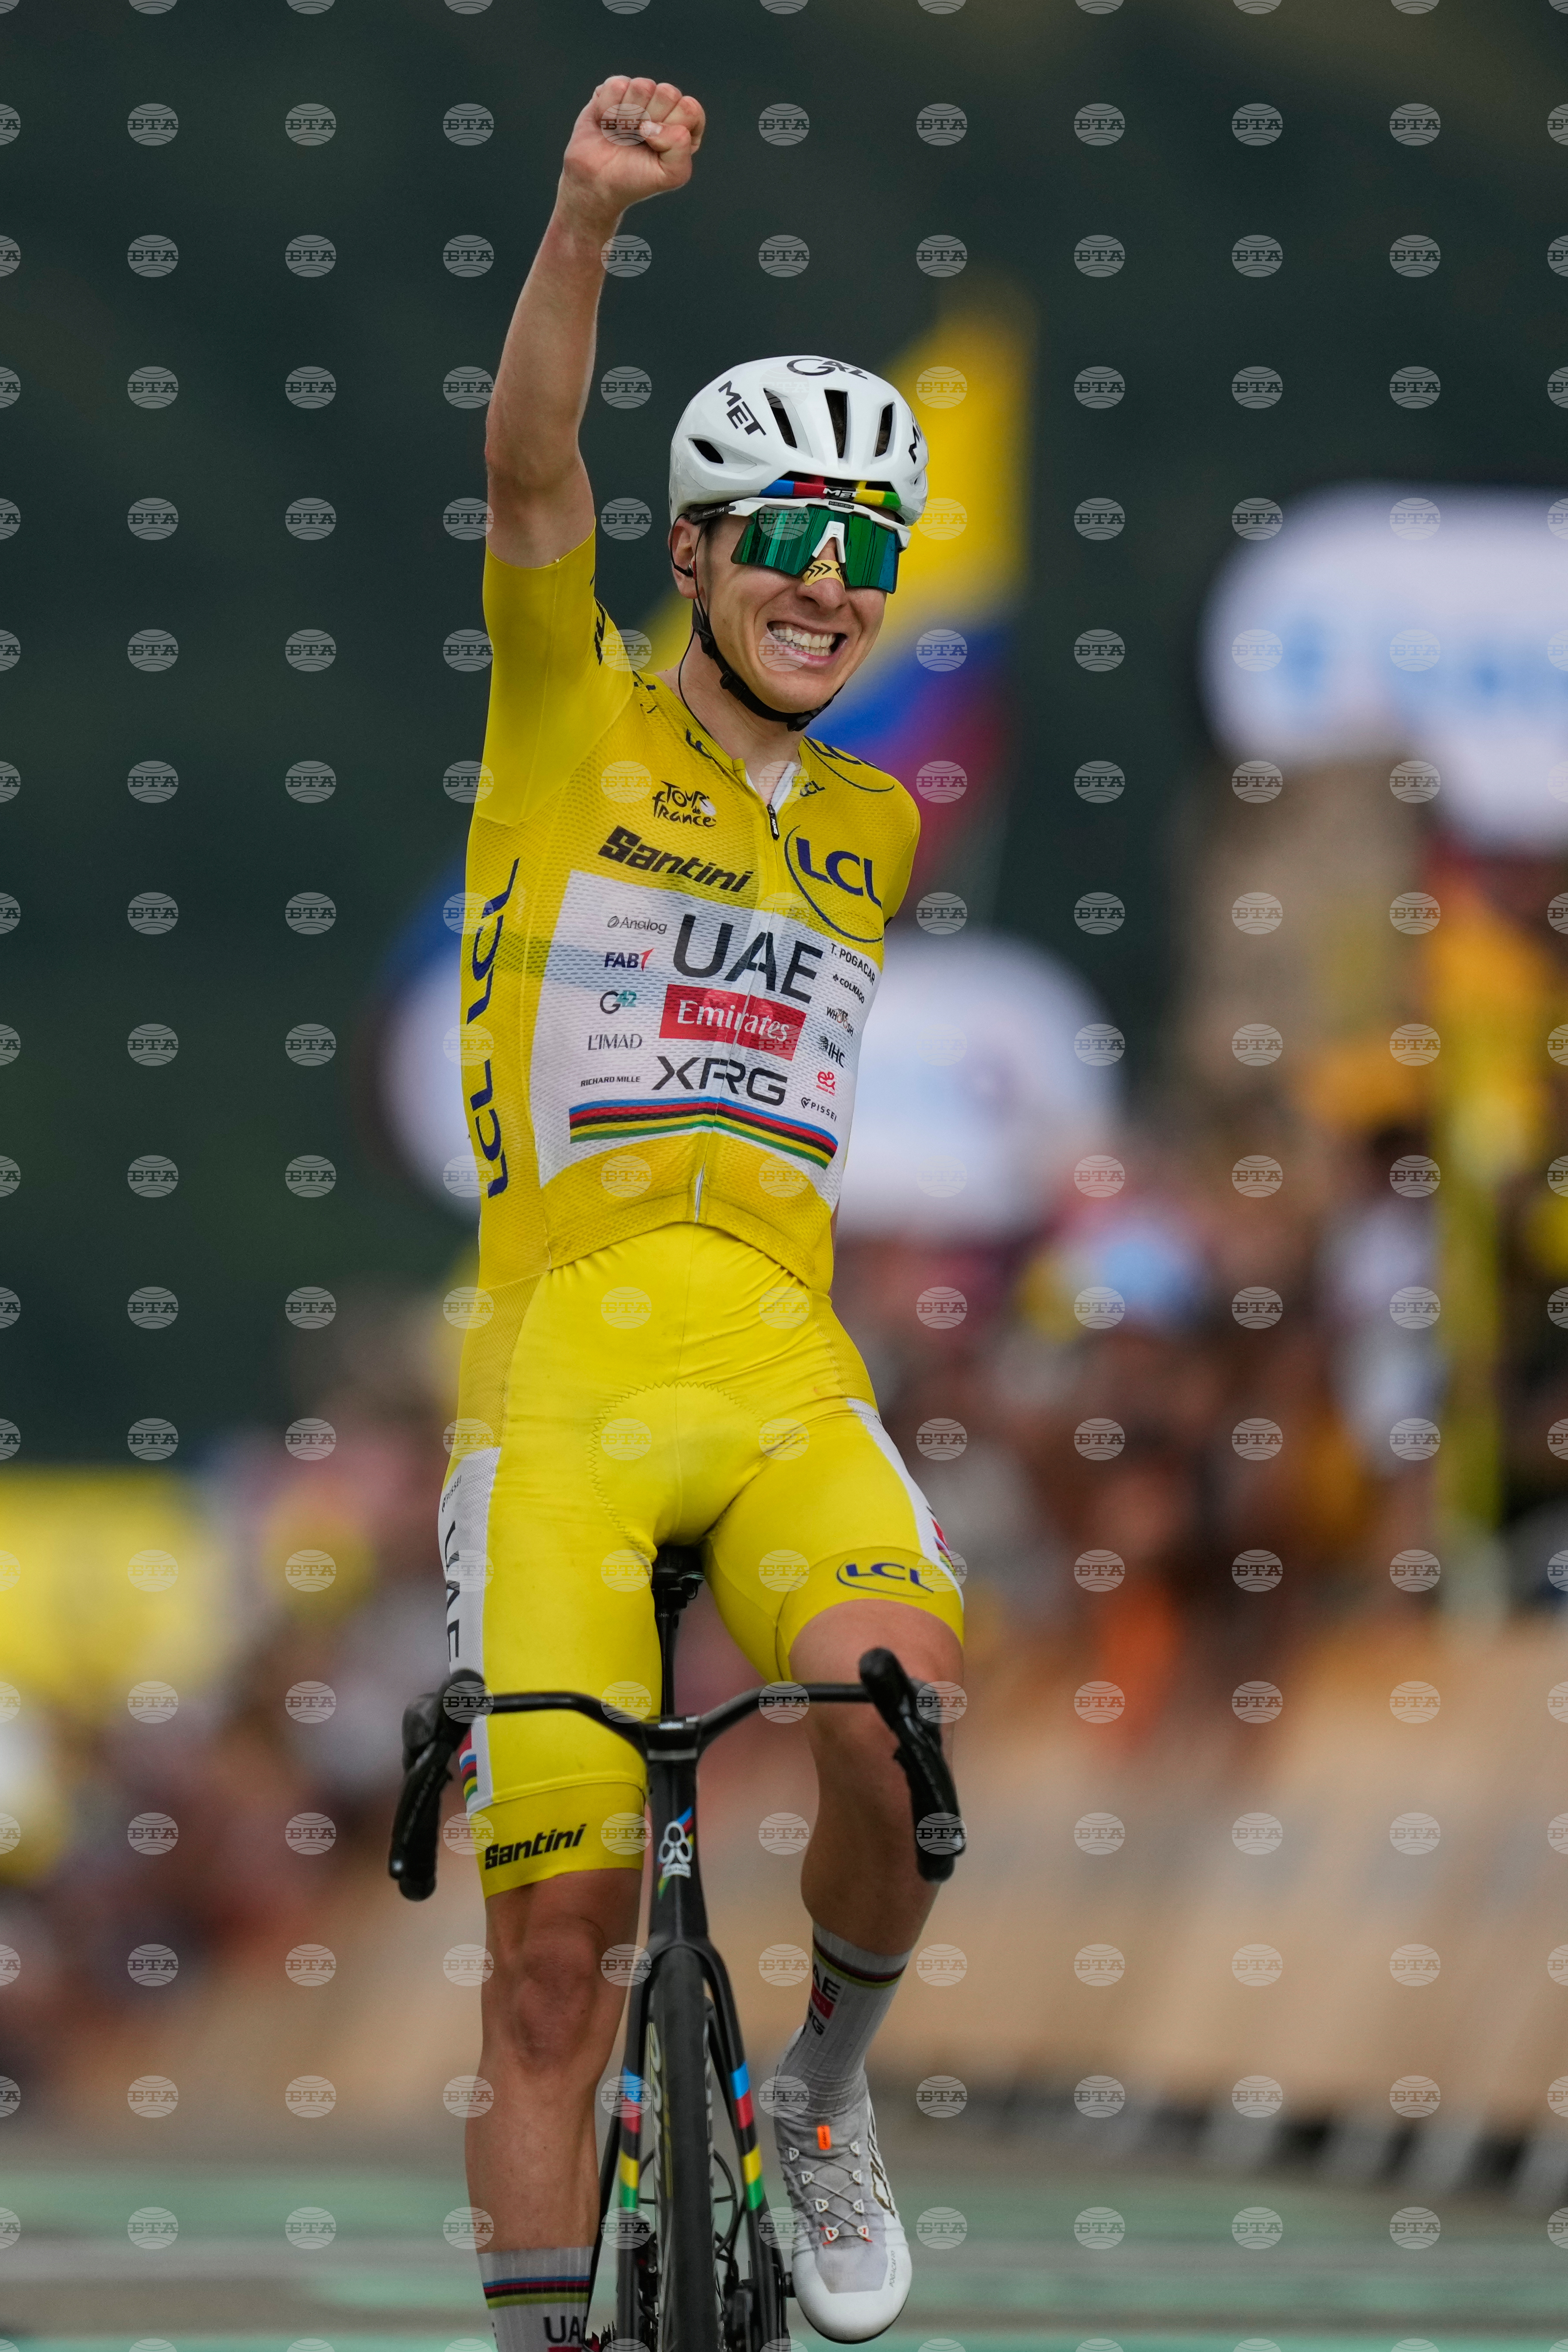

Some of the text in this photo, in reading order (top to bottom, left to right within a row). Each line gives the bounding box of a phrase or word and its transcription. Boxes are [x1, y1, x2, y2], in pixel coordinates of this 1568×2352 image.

[718, 380, 766, 436] MET
[823, 487, 861, 498] MET
[686, 728, 712, 759] LC
[799, 780, 825, 797] LCL
[598, 825, 754, 893] Santini
[795, 837, 882, 911] LCL
[467, 858, 520, 1025] LCL
[619, 917, 667, 934] Analog
[673, 914, 823, 1004] UAE
[831, 943, 875, 986] T. POGACAR
[600, 990, 637, 1014] G42
[840, 978, 865, 1004] COLNAGO
[677, 999, 789, 1042] Emirates
[828, 1042, 845, 1068] IHC
[580, 1076, 615, 1087] RICHARD
[651, 1056, 788, 1106] XRG
[470, 1059, 508, 1199] LCL
[811, 1101, 837, 1122] PISSEI
[845, 1562, 934, 1593] LCL
[485, 1823, 587, 1870] Santini
[812, 1964, 841, 2003] AE
[543, 2316, 586, 2343] UA
